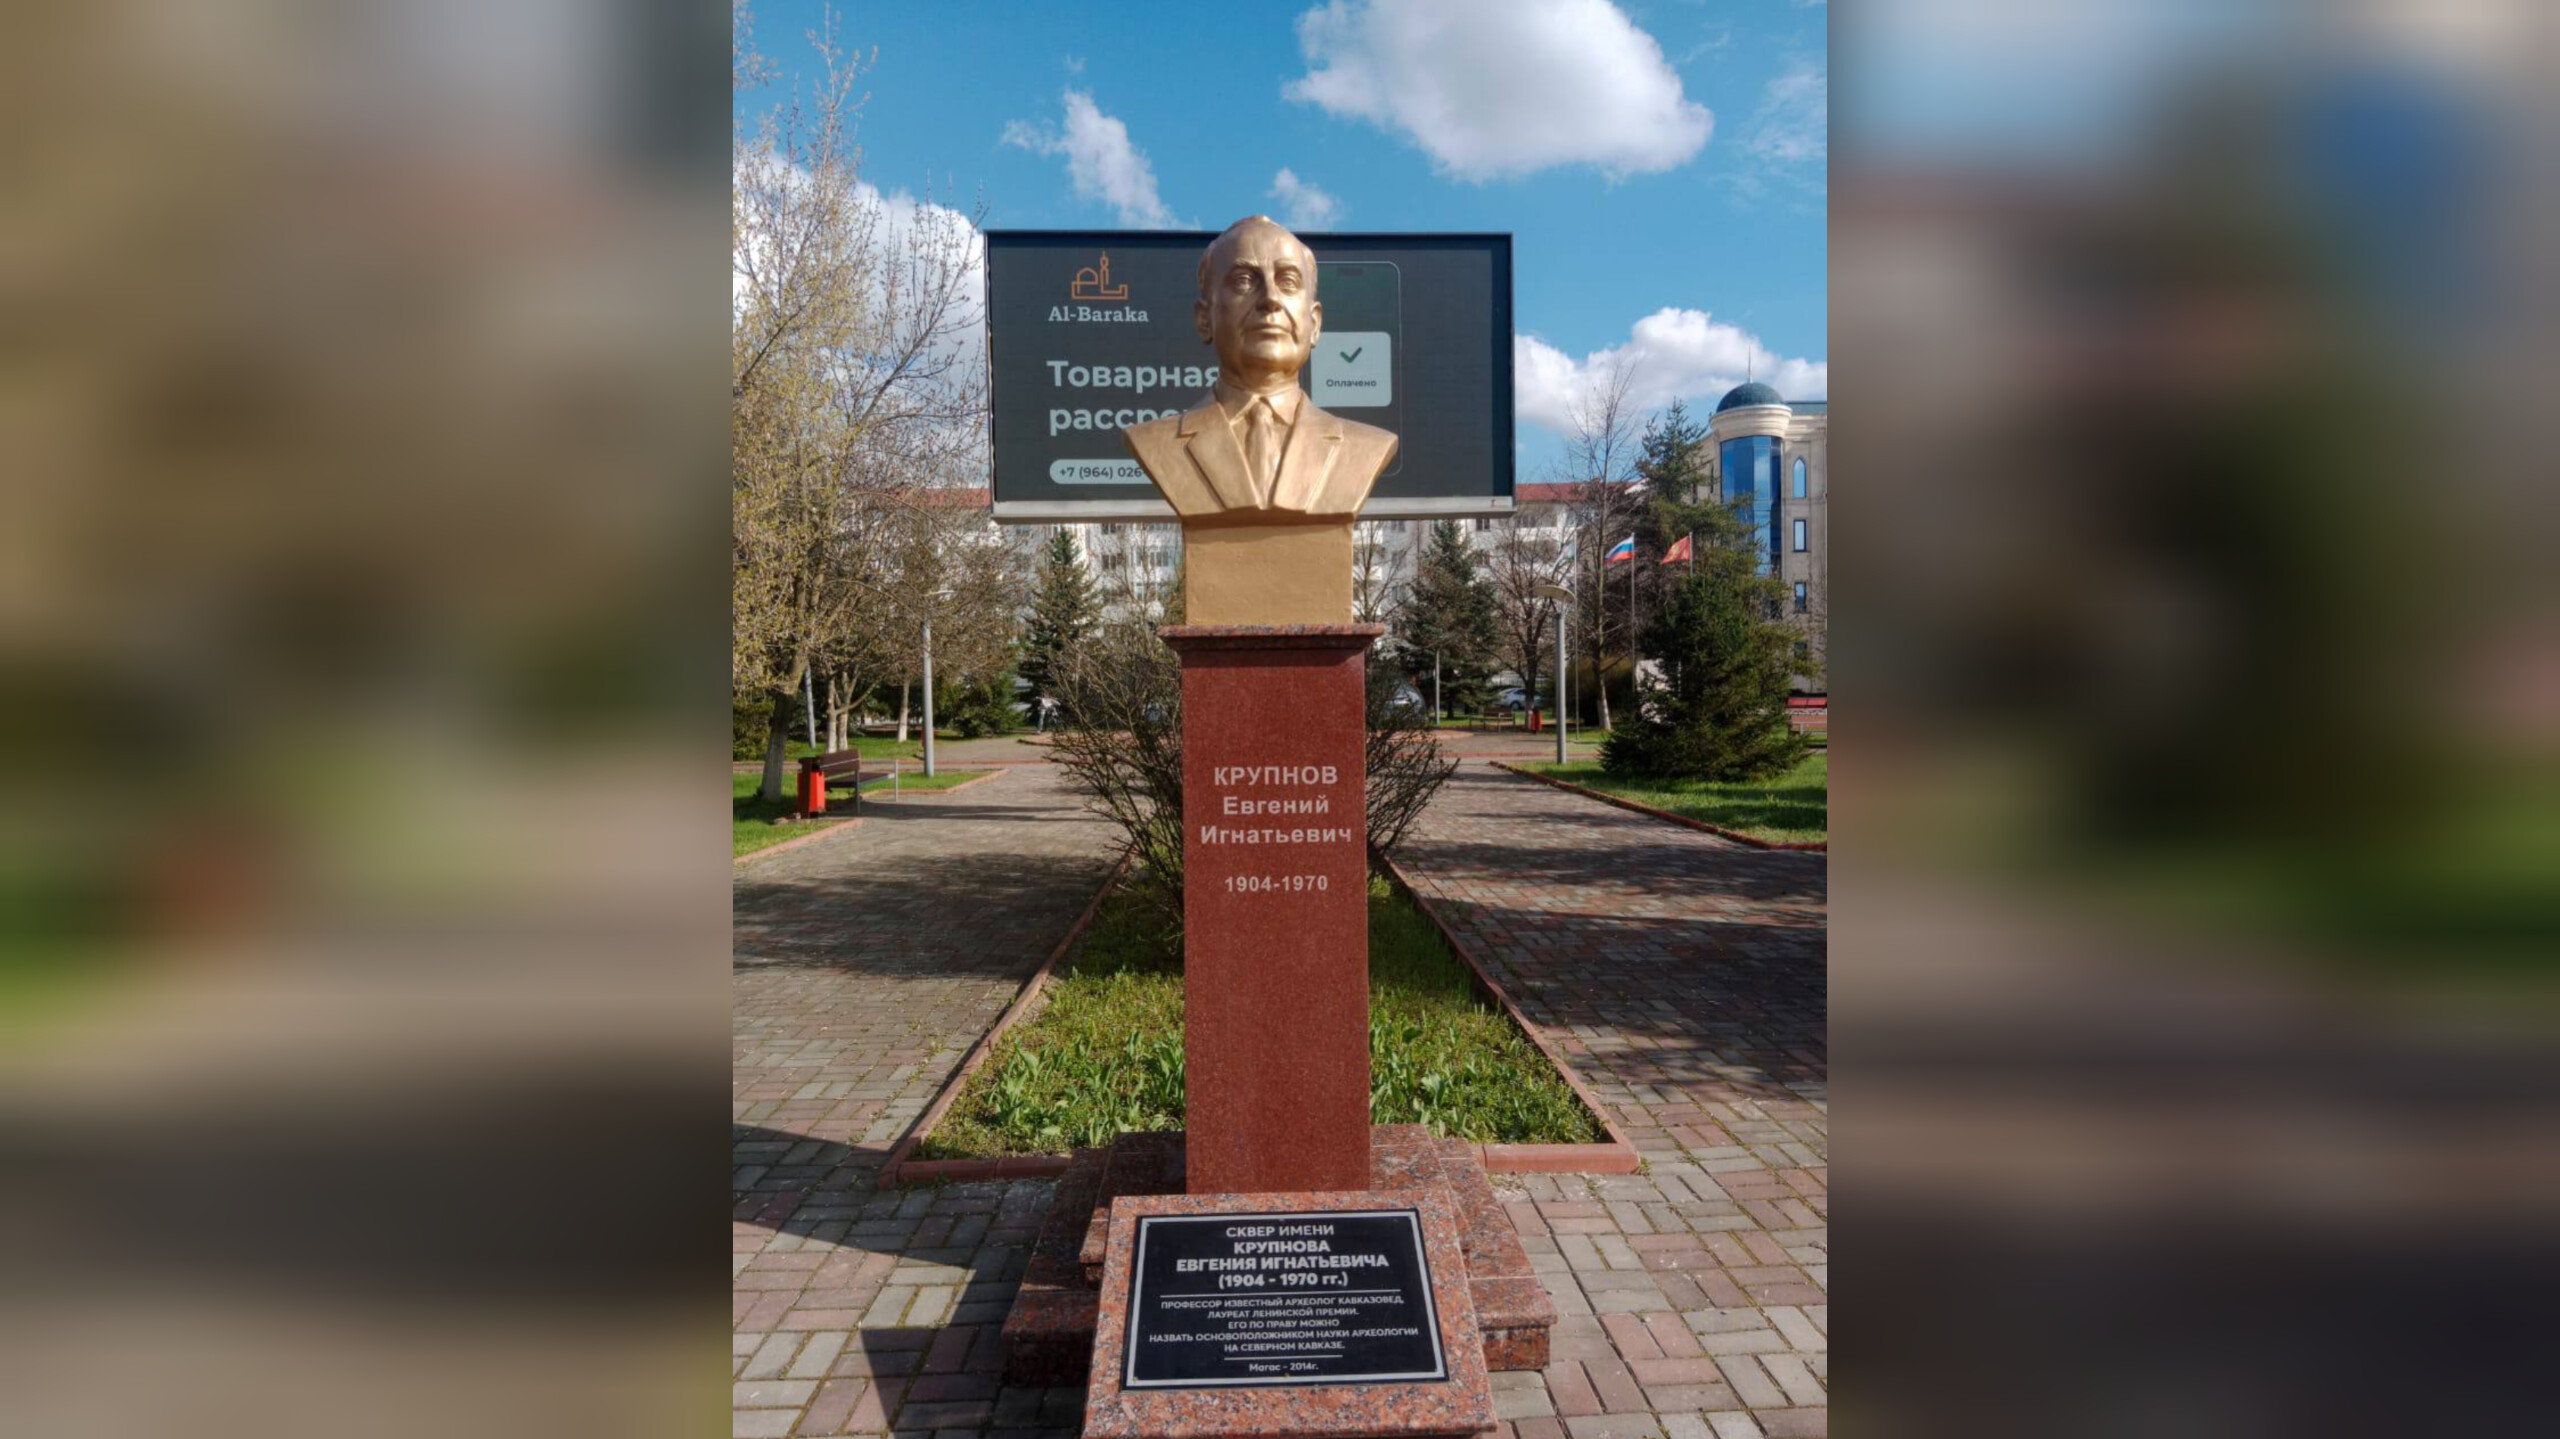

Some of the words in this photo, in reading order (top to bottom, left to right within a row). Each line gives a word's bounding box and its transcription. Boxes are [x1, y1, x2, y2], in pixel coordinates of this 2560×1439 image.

[1048, 305, 1149, 322] Al-Baraka
[1046, 360, 1220, 394] Товарная
[1326, 378, 1377, 388] Оплачено
[1050, 409, 1187, 436] расср
[1059, 467, 1075, 477] +7
[1079, 466, 1113, 480] (964)
[1214, 766, 1338, 786] КРУПНОВ
[1223, 794, 1329, 815] Евгений
[1201, 825, 1351, 844] Игнатьевич
[1224, 875, 1328, 892] 1904-1970
[1226, 1226, 1275, 1238] СКВЕР
[1279, 1224, 1335, 1236] ИМЕНИ
[1234, 1239, 1331, 1254] КРУПНОВА
[1176, 1257, 1257, 1272] ЕВГЕНИЯ
[1261, 1254, 1390, 1270] ИГНАТЬЕВИЧА
[1218, 1274, 1265, 1290] (1904
[1280, 1272, 1318, 1286] 1970
[1322, 1271, 1348, 1287] гг.)
[1161, 1300, 1222, 1309] ПРОФЕССОР
[1224, 1297, 1283, 1308] ИЗВЕСТНЫЙ
[1284, 1297, 1336, 1306] АРХЕОЛОГ
[1207, 1310, 1250, 1319] ЛАУРЕАТ
[1252, 1307, 1313, 1318] ЛЕНИНСКОЙ
[1228, 1321, 1247, 1330] ЕГО
[1249, 1320, 1265, 1329] ПО
[1266, 1320, 1297, 1328] ПРАВУ
[1300, 1318, 1340, 1327] МОЖНО
[1149, 1333, 1193, 1343] НАЗВАТЬ
[1195, 1329, 1315, 1341] ОСНОВОПОЛОЖНИКОМ
[1316, 1329, 1350, 1338] НАУКИ
[1351, 1327, 1419, 1337] АРХЕОЛОГИИ
[1224, 1343, 1239, 1352] НА
[1240, 1341, 1296, 1352] СЕВЕРНОМ
[1298, 1340, 1345, 1350] КАВКАЗЕ.
[1249, 1362, 1281, 1372] Магас
[1290, 1361, 1319, 1371] 2014г.
